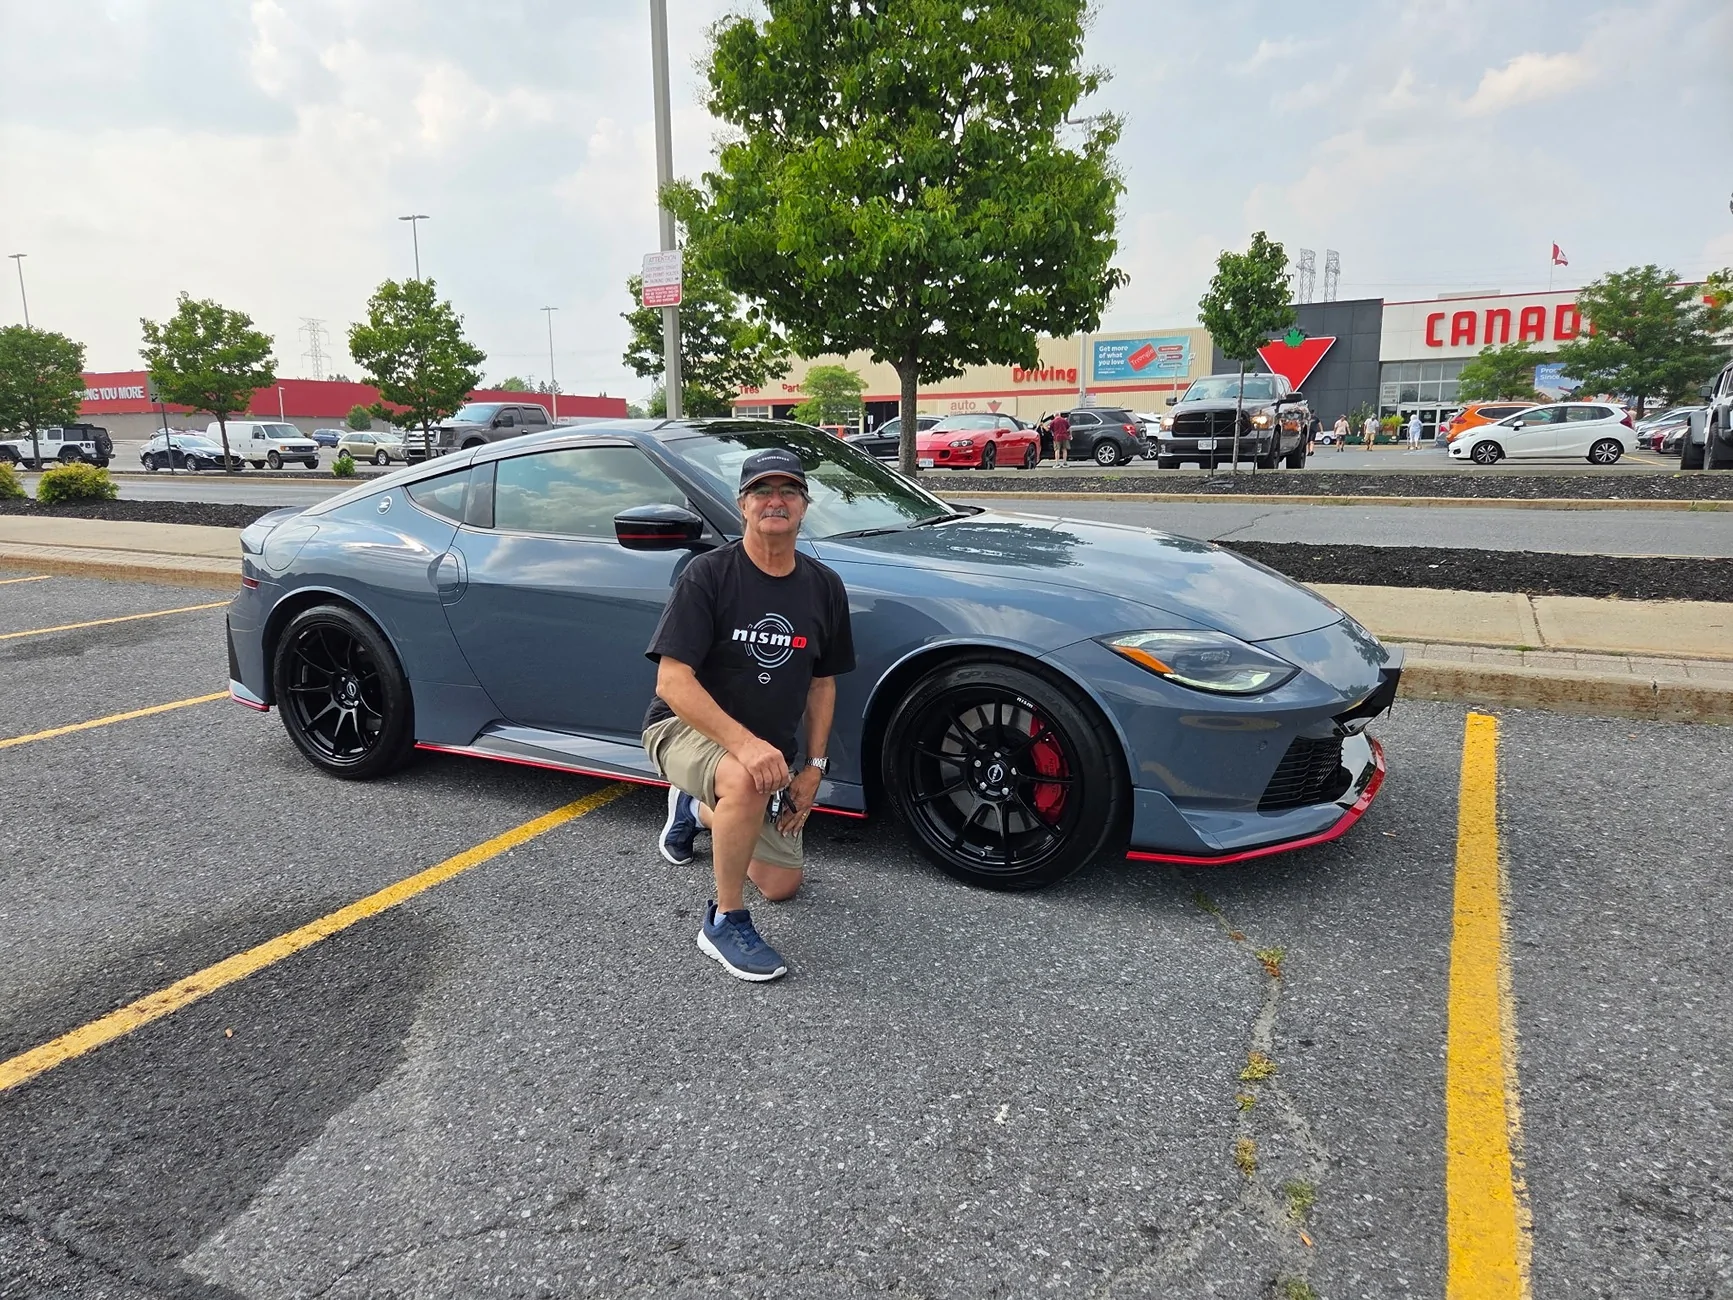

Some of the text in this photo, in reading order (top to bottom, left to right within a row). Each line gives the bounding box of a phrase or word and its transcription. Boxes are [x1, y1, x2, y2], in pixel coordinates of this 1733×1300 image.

[1130, 348, 1155, 366] Triangle
[1012, 366, 1077, 383] Driving
[100, 387, 118, 400] YOU
[119, 386, 145, 399] MORE
[739, 384, 759, 394] Tires
[782, 383, 801, 393] Part
[950, 400, 976, 411] auto
[732, 628, 807, 648] nismo
